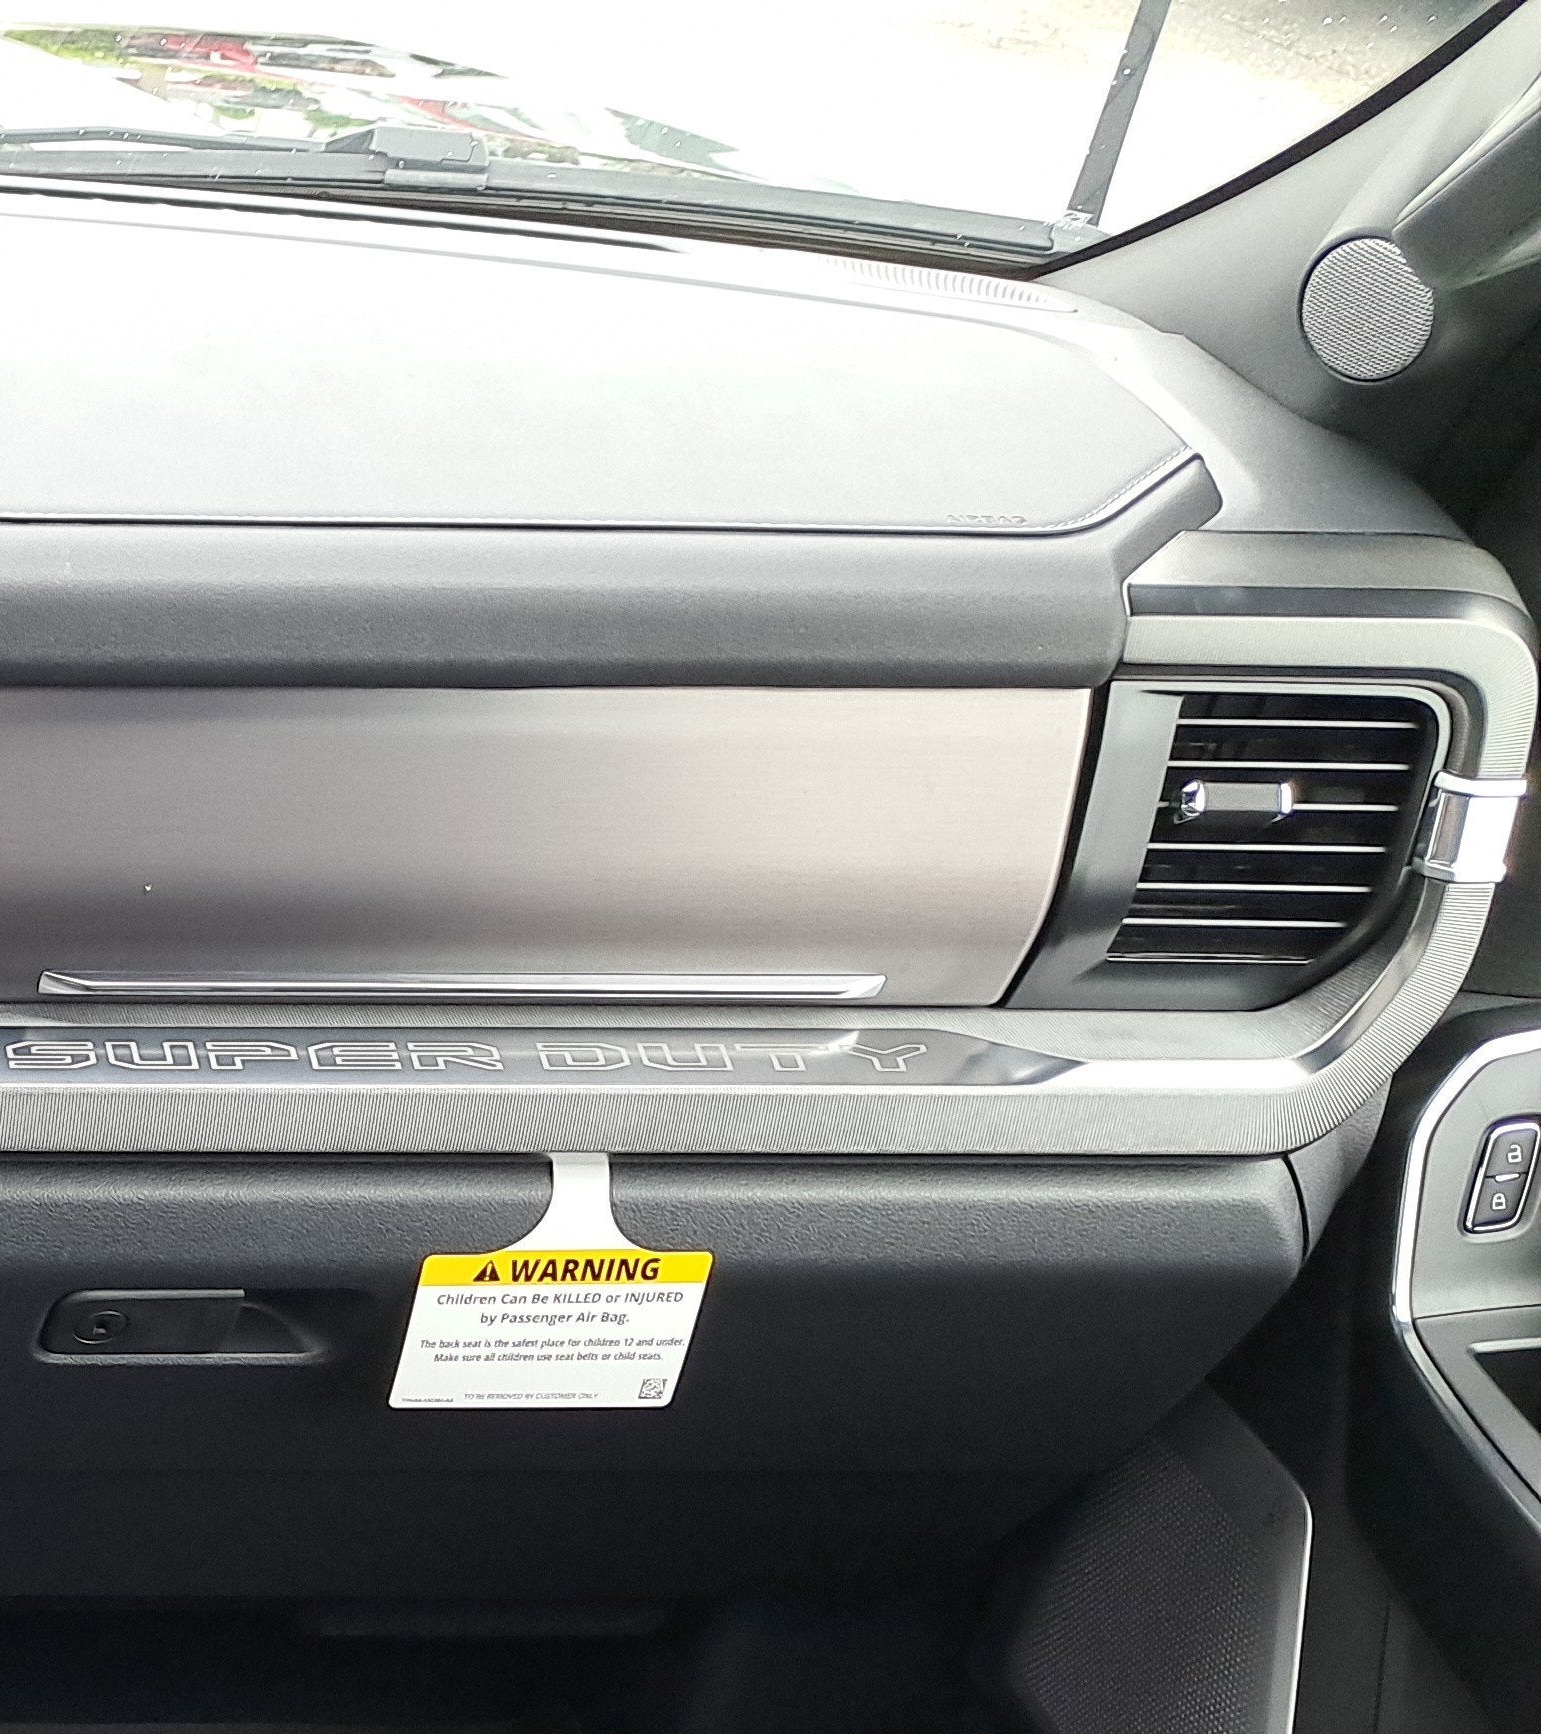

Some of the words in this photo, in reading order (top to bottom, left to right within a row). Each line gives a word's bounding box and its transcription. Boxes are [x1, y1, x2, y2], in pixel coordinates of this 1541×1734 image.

[4, 1040, 504, 1071] SUPER
[535, 1041, 928, 1072] DUTY
[511, 1258, 661, 1283] WARNING
[437, 1294, 496, 1305] Children
[501, 1294, 526, 1304] Can
[531, 1293, 549, 1304] Be
[553, 1292, 602, 1304] KILLED
[605, 1294, 621, 1304] or
[624, 1292, 684, 1304] INJURED
[480, 1312, 497, 1326] by
[501, 1312, 573, 1326] Passenger
[576, 1311, 597, 1323] Air
[601, 1312, 630, 1326] Bag.
[420, 1339, 437, 1349] The
[438, 1339, 460, 1349] back
[462, 1340, 481, 1349] seat
[484, 1339, 491, 1348] is
[494, 1339, 510, 1348] the
[511, 1338, 538, 1348] safest
[540, 1338, 565, 1350] place
[567, 1338, 580, 1347] for
[584, 1337, 620, 1347] children
[624, 1338, 634, 1347] 12
[636, 1337, 654, 1347] and
[656, 1337, 685, 1347] under.
[434, 1353, 459, 1362] Make
[461, 1353, 481, 1362] sure
[483, 1352, 495, 1362] all
[497, 1352, 534, 1362] children
[536, 1353, 552, 1361] use
[555, 1352, 574, 1361] seat
[576, 1352, 598, 1361] belts
[614, 1352, 635, 1360] child
